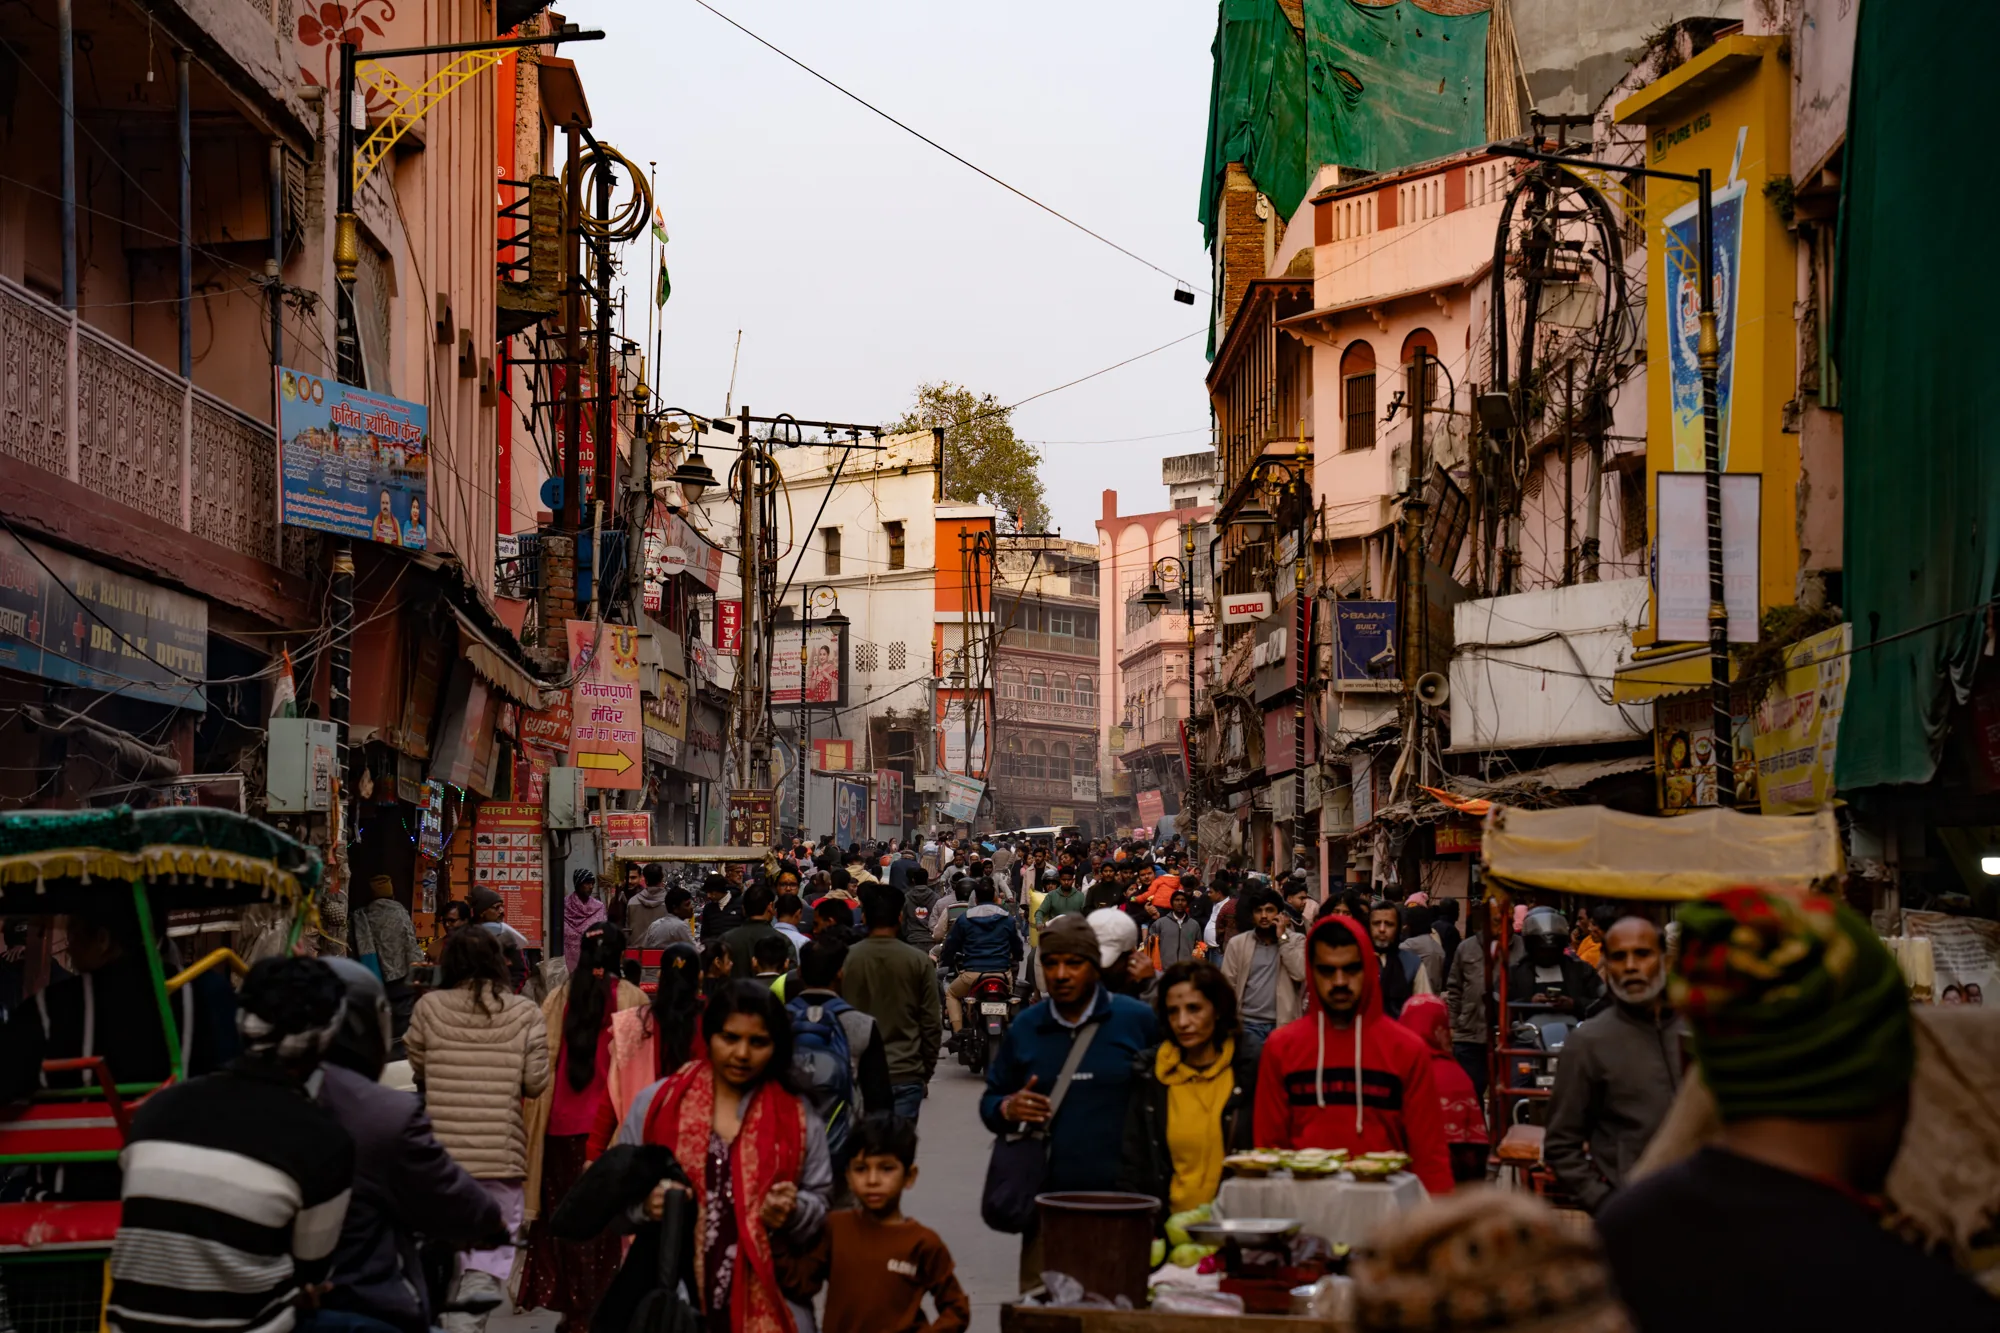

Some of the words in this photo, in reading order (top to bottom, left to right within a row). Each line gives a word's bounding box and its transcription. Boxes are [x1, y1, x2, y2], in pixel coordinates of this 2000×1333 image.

[1667, 123, 1690, 149] PURE
[1692, 112, 1711, 134] VEG
[330, 401, 361, 429] फलित
[363, 409, 399, 439] ज्योतिष
[401, 418, 422, 445] केन्द्र
[1229, 602, 1264, 615] USHA
[1349, 612, 1386, 620] BAJAJ
[90, 624, 117, 654] DR.
[156, 641, 204, 674] DUTTA
[580, 681, 633, 704] अन्नपूर्णा
[591, 705, 624, 723] मंदिर
[524, 716, 560, 737] GUEST
[576, 725, 594, 740] जाने
[598, 728, 609, 741] का
[612, 729, 637, 743] रास्ता
